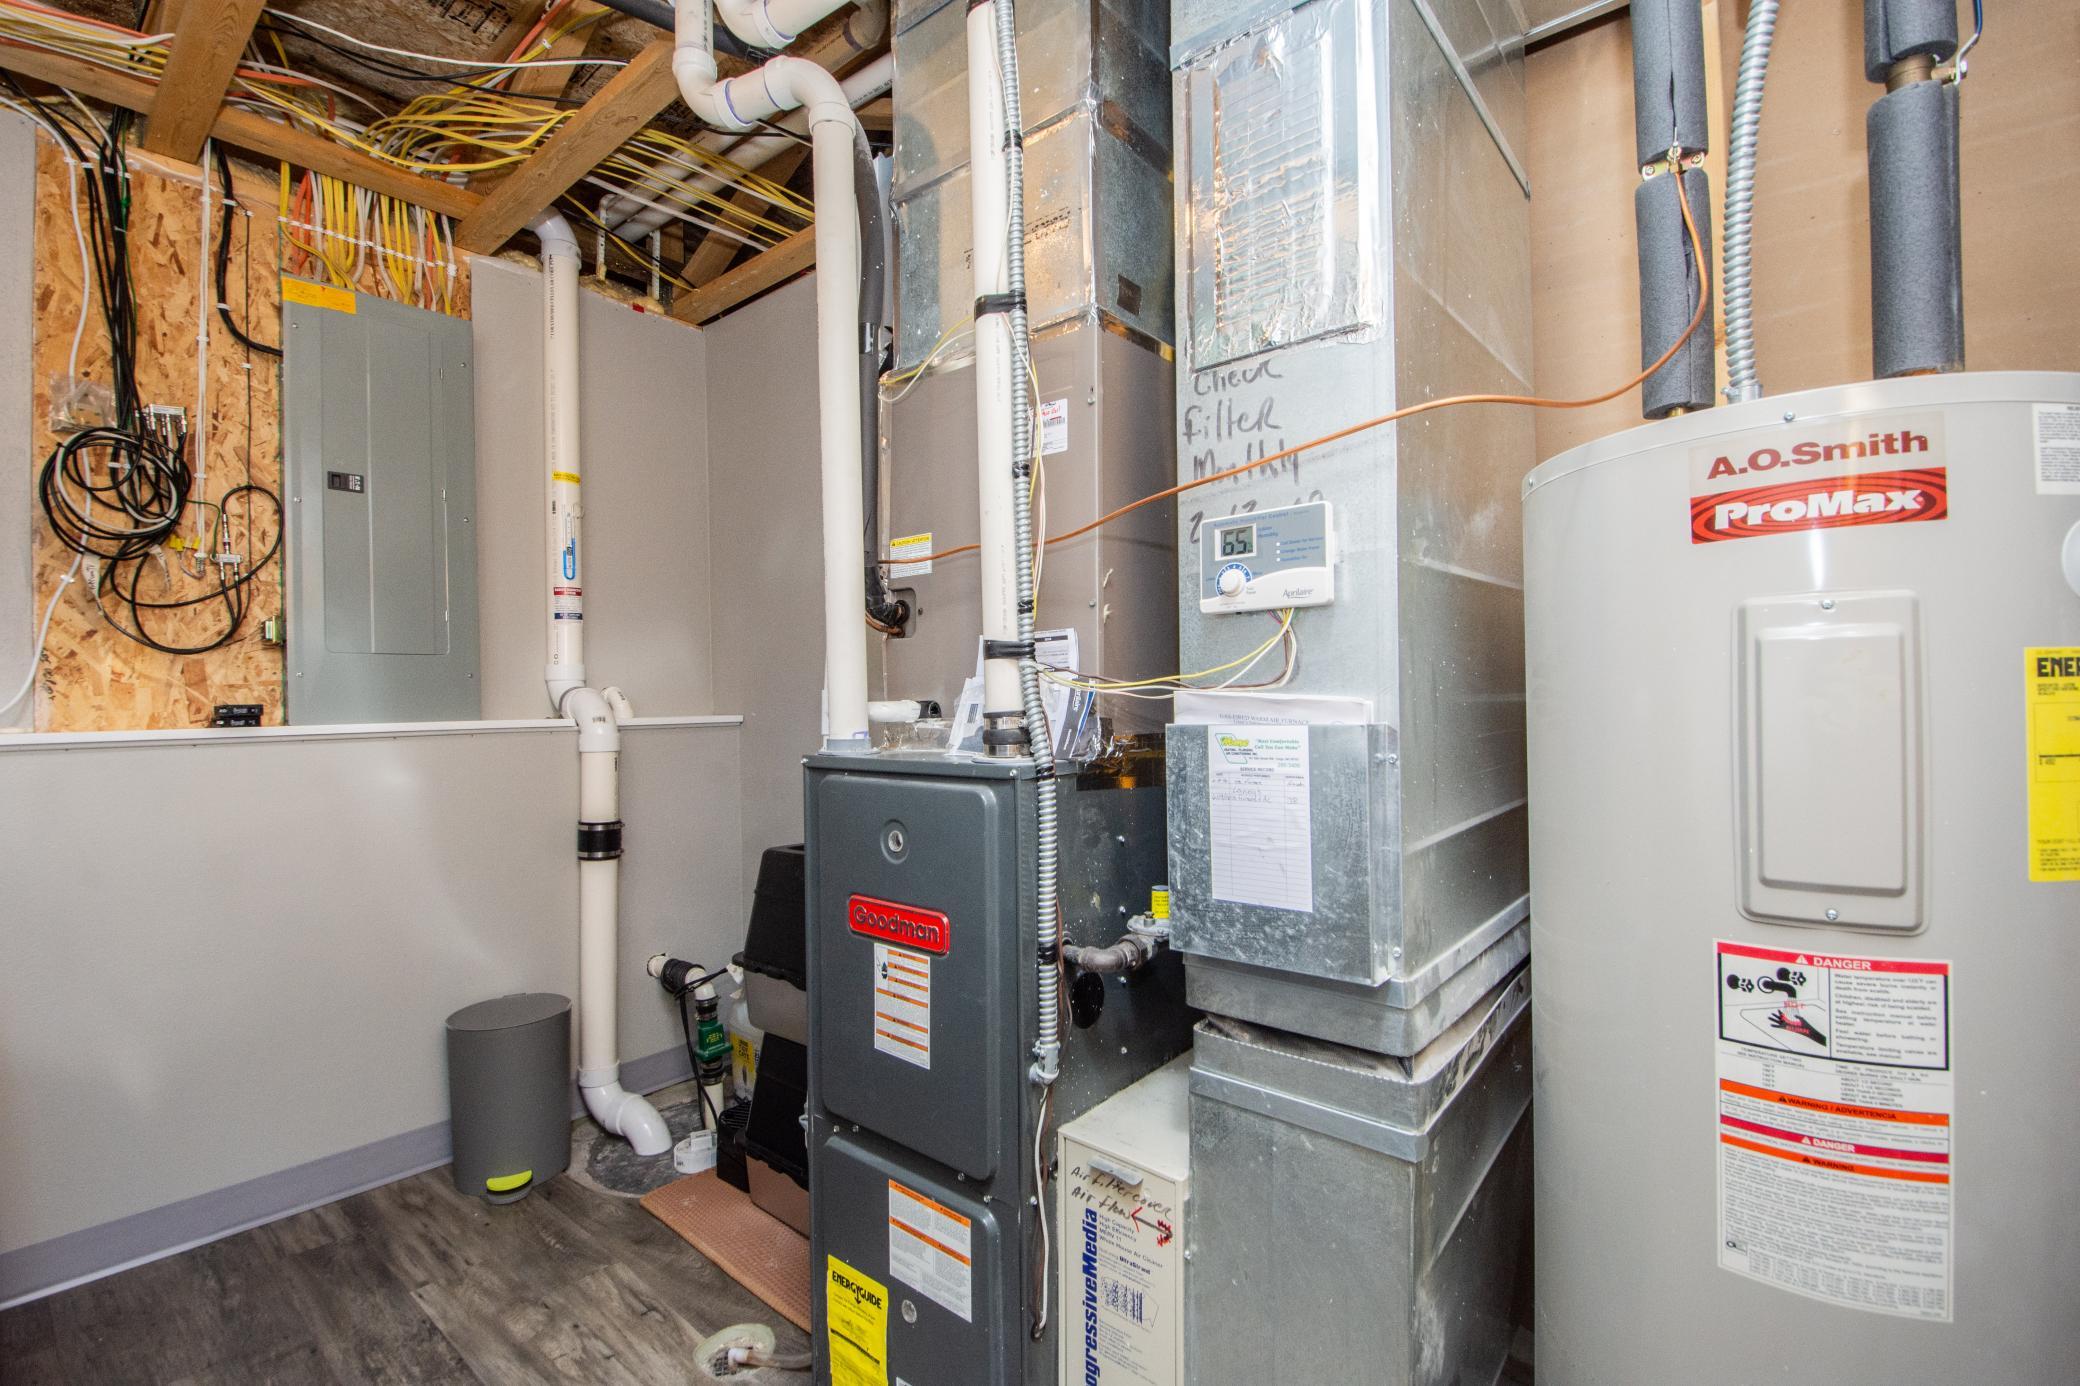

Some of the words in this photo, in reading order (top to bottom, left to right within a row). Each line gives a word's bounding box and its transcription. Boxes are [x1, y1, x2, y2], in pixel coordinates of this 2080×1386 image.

[1715, 490, 1923, 530] ProMax
[1223, 529, 1247, 556] 65
[854, 905, 940, 944] Goodman
[1813, 956, 1872, 971] DANGER
[1788, 1098, 1828, 1111] WARNING
[1835, 1106, 1897, 1120] ADVERTENCIA
[1813, 1137, 1856, 1153] DANGER
[1813, 1159, 1855, 1172] WARNING
[832, 1271, 882, 1310] ENERGYGUIDE
